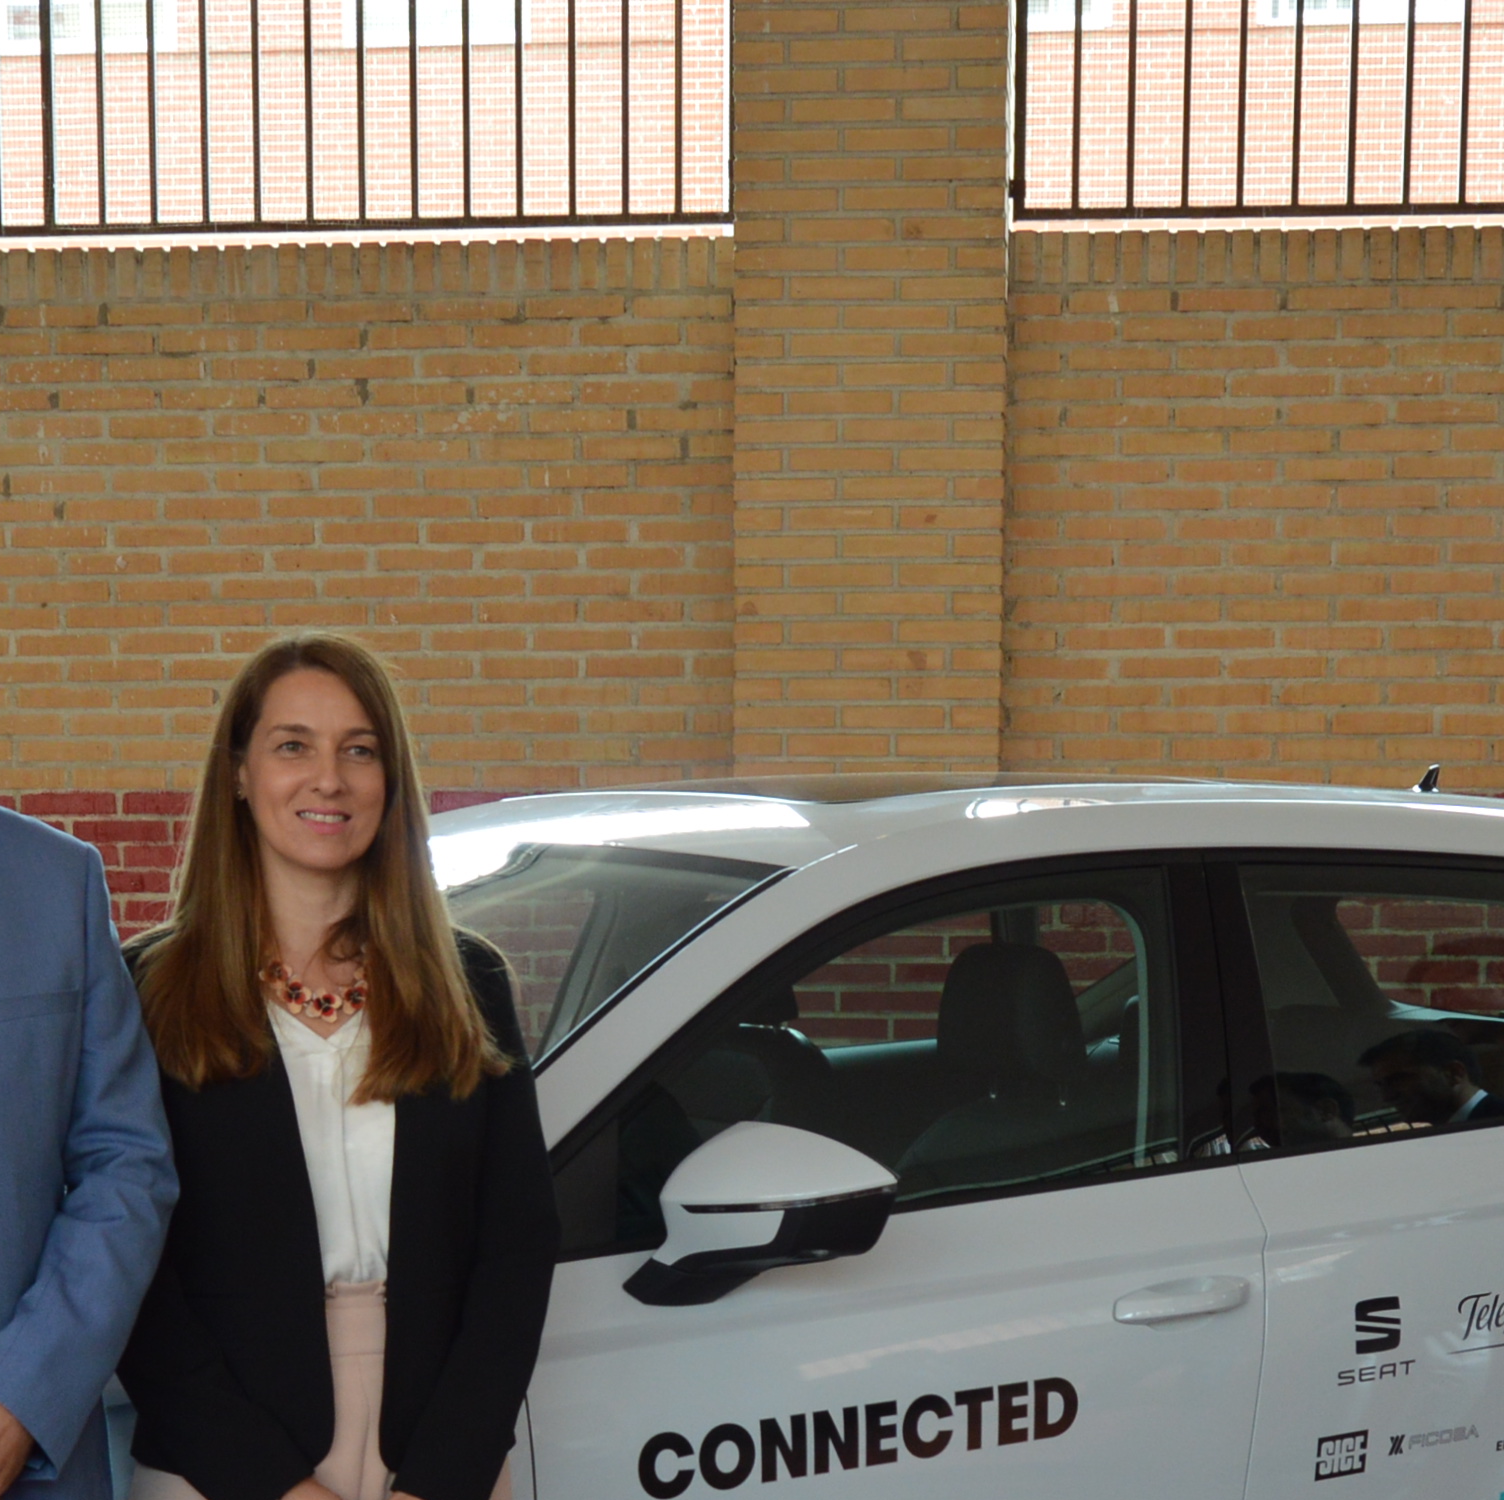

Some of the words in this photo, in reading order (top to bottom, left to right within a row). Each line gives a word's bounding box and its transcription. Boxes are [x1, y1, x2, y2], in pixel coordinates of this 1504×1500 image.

[1337, 1358, 1416, 1386] SEAT
[638, 1377, 1078, 1500] CONNECTED
[1408, 1424, 1479, 1450] FICOSA
